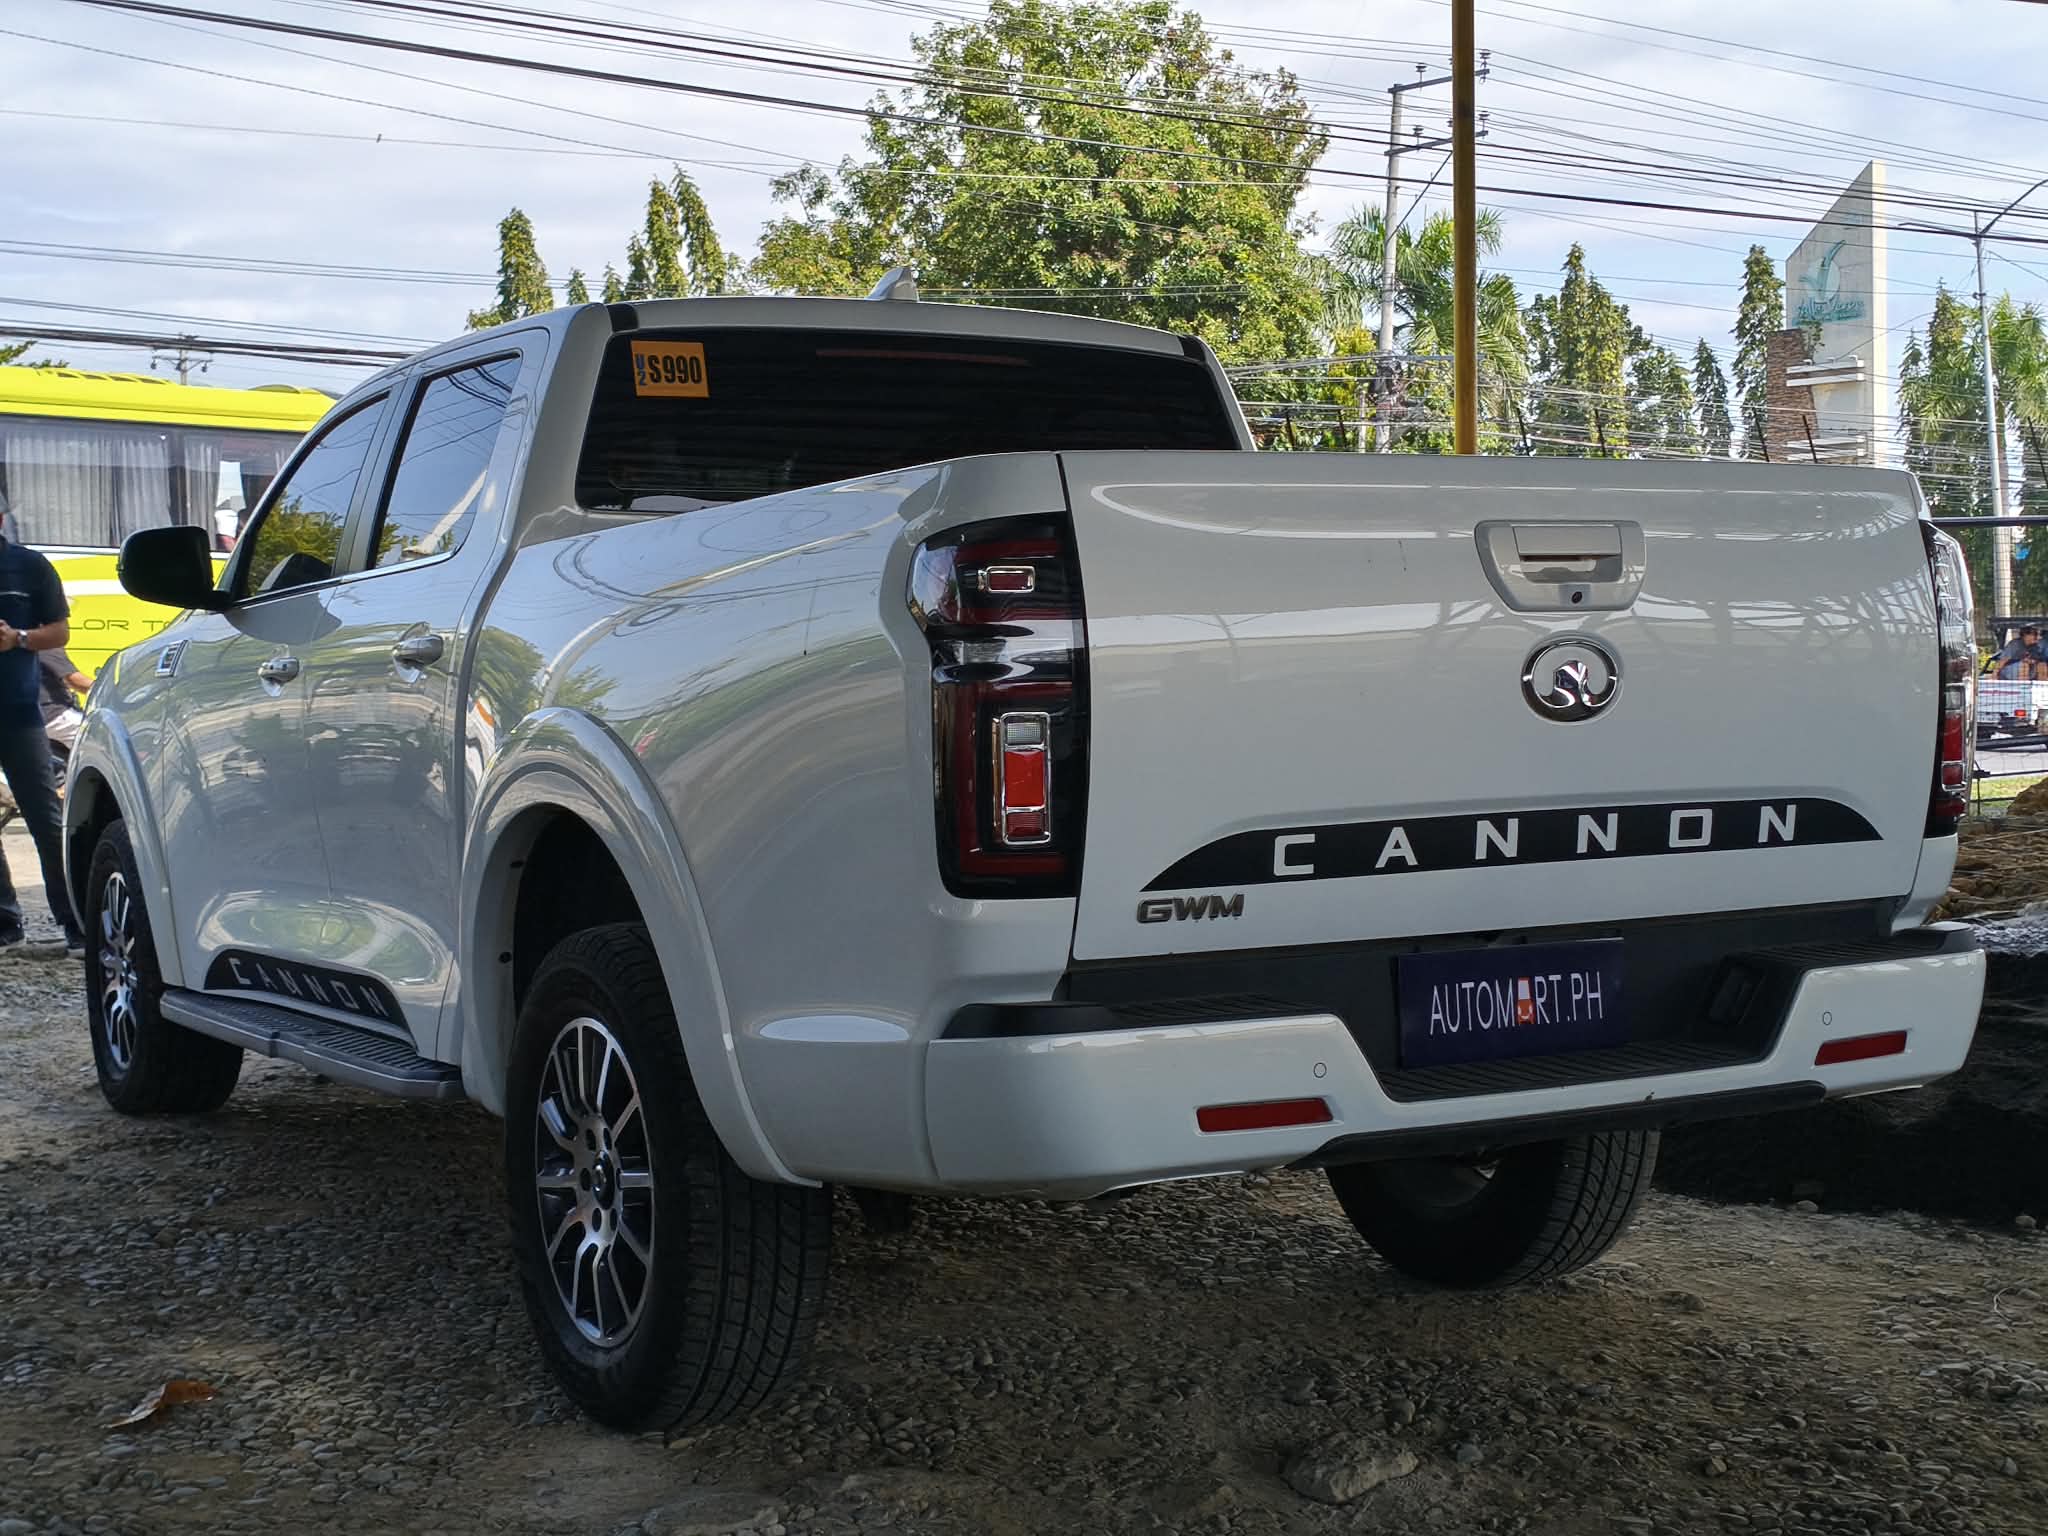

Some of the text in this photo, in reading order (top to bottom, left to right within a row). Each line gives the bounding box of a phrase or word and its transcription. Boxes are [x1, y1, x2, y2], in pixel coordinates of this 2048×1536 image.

[647, 354, 702, 384] S990
[1272, 803, 1797, 877] CANNON
[1136, 893, 1245, 924] GWM
[227, 957, 390, 1017] CANNON
[1430, 971, 1603, 1036] AUTOMRT.PH
